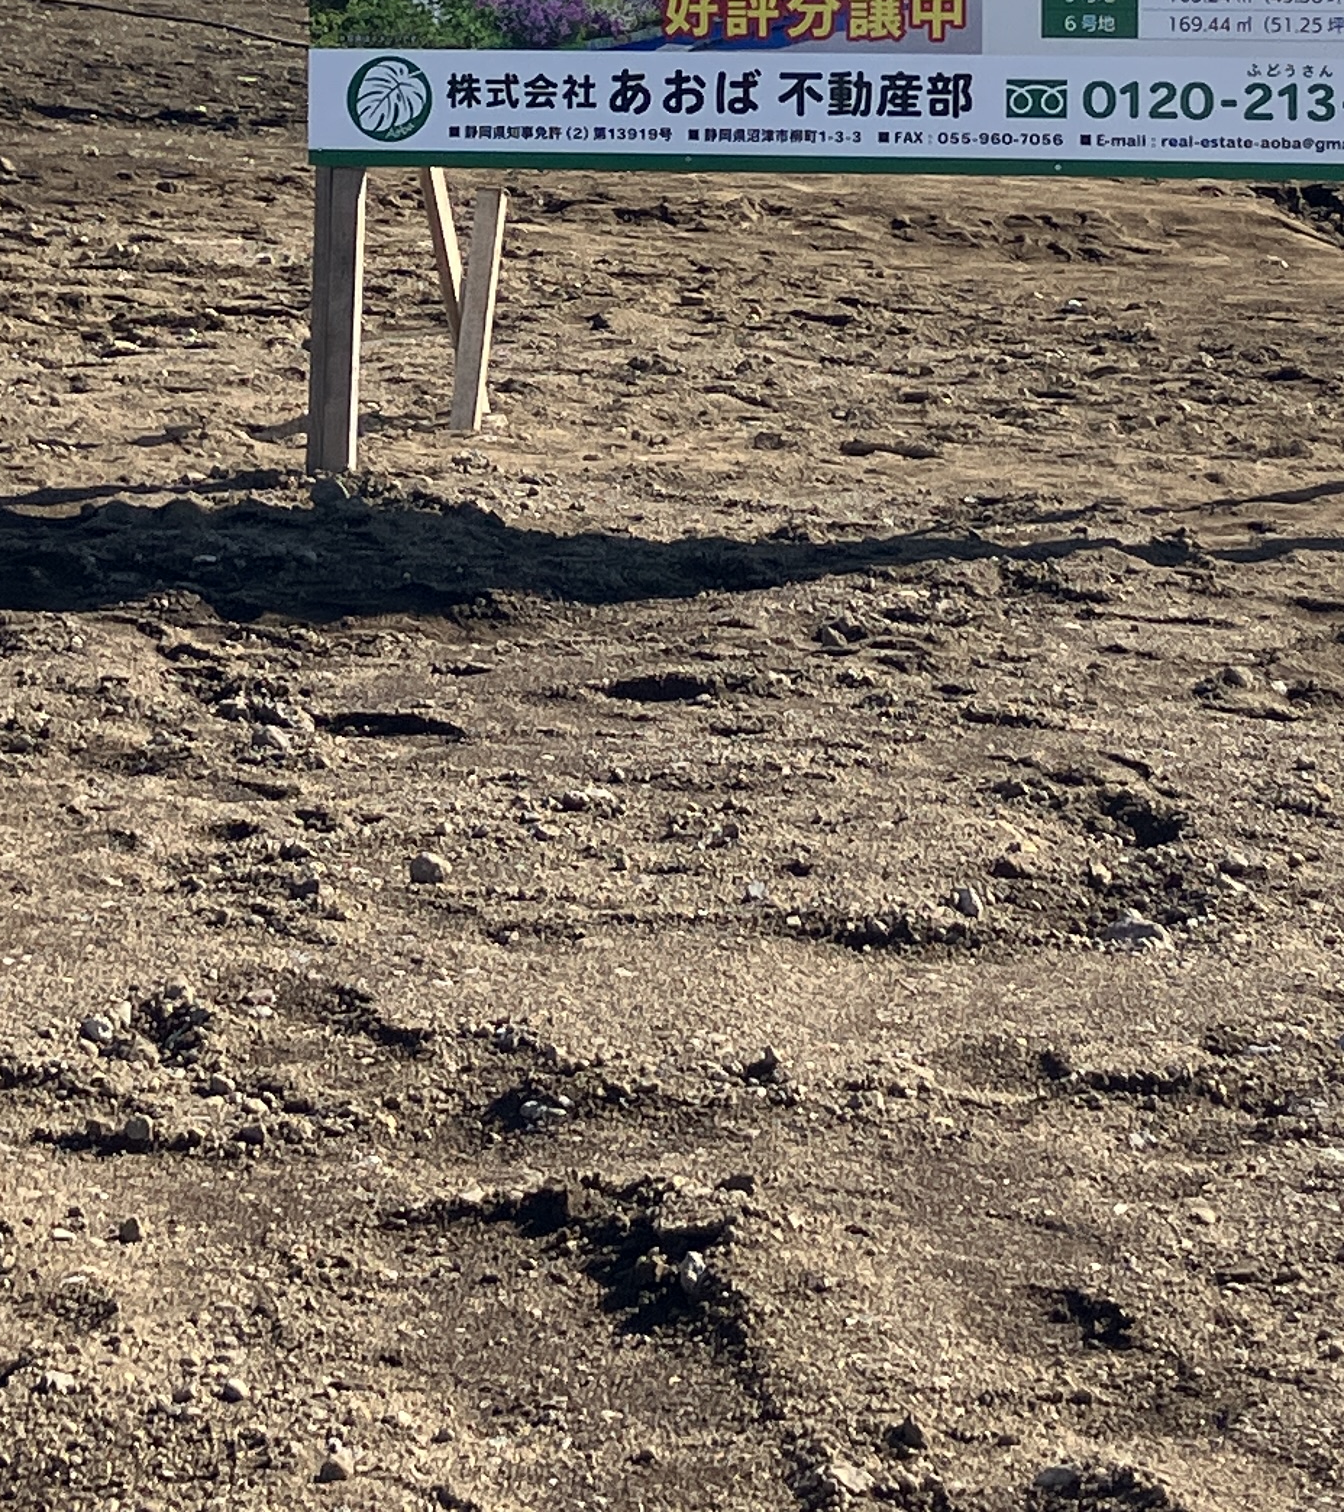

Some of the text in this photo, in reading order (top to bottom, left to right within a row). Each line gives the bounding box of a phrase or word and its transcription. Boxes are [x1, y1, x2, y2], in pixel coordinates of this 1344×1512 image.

[1246, 63, 1334, 79] ふどうさん
[445, 67, 973, 120] 株式会社 あおば 不動産部
